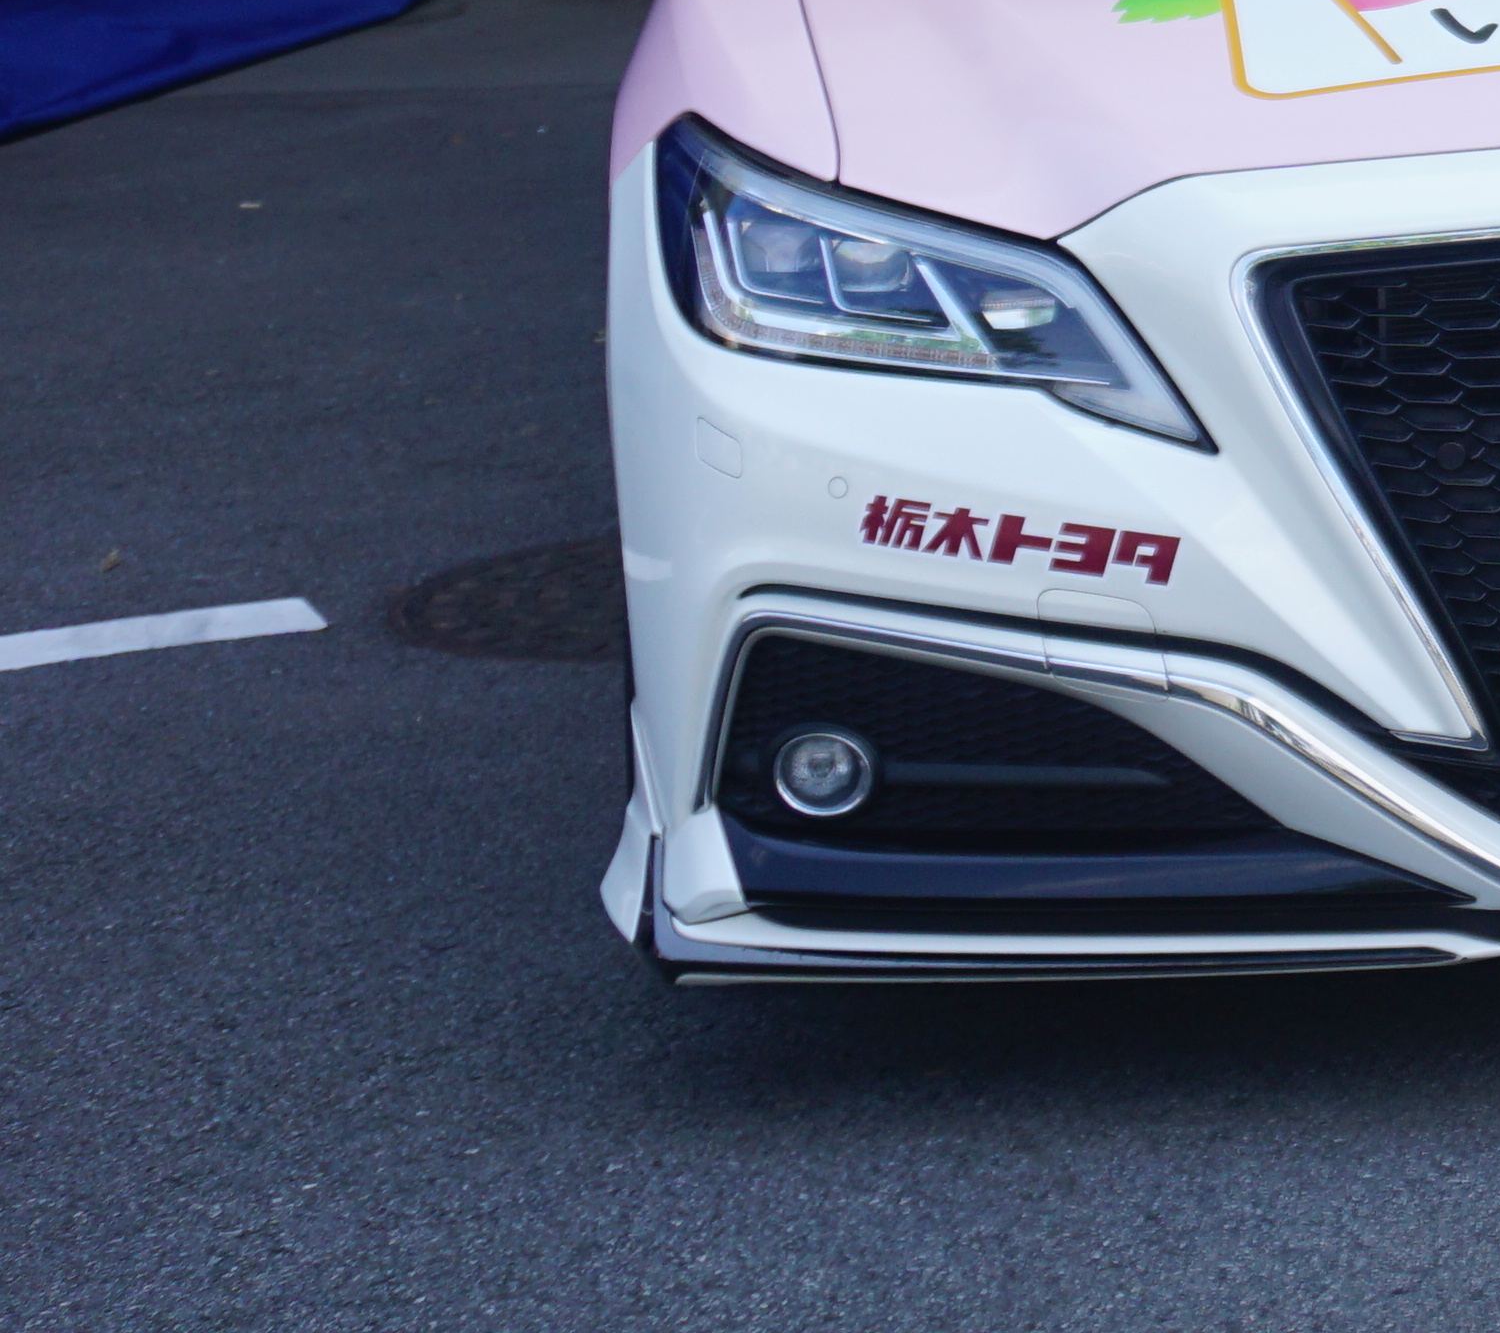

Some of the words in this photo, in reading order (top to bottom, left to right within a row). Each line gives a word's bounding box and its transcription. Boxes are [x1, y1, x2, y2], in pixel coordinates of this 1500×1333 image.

[858, 494, 1182, 587] 栃木トヨタ
